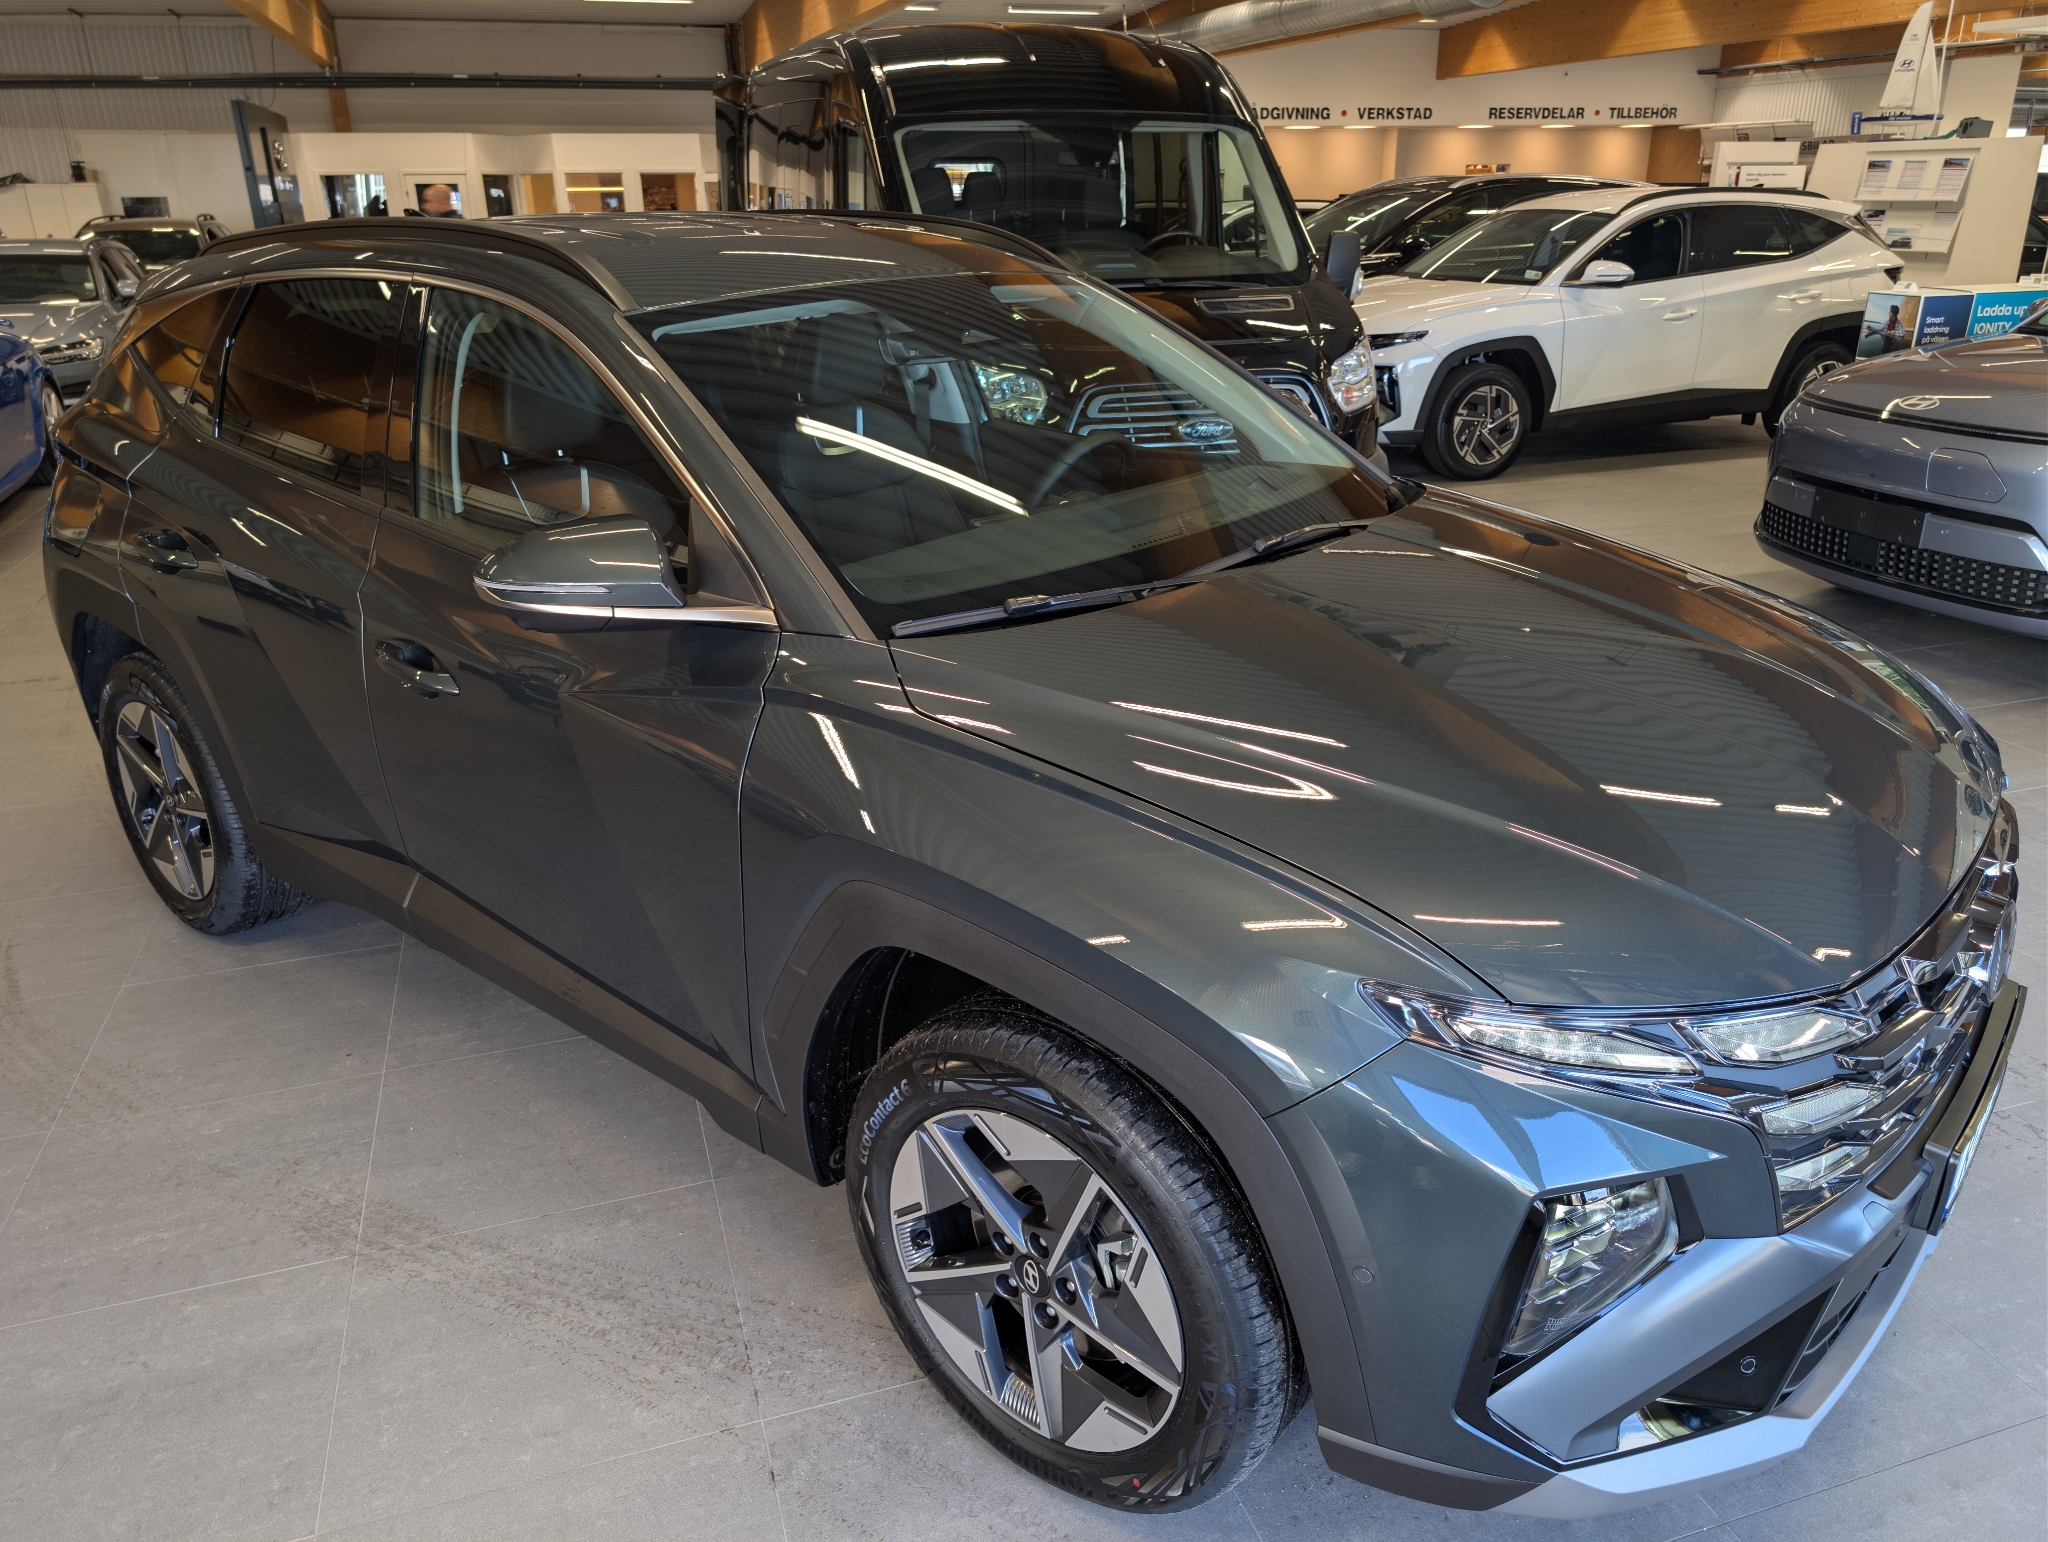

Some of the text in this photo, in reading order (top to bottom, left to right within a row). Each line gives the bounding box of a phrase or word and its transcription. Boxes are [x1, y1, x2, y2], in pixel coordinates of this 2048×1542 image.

[1357, 107, 1433, 120] VERKSTAD
[1488, 103, 1678, 120] RESERVDELAR TILLBEHÖR
[1976, 303, 2013, 317] Ladda
[1925, 316, 1945, 324] Smart
[1923, 325, 1950, 335] laddning
[1973, 321, 2012, 335] IONITY
[1920, 335, 1931, 345] på
[1192, 422, 1224, 437] Ford
[859, 1078, 913, 1166] EcoContact 6
